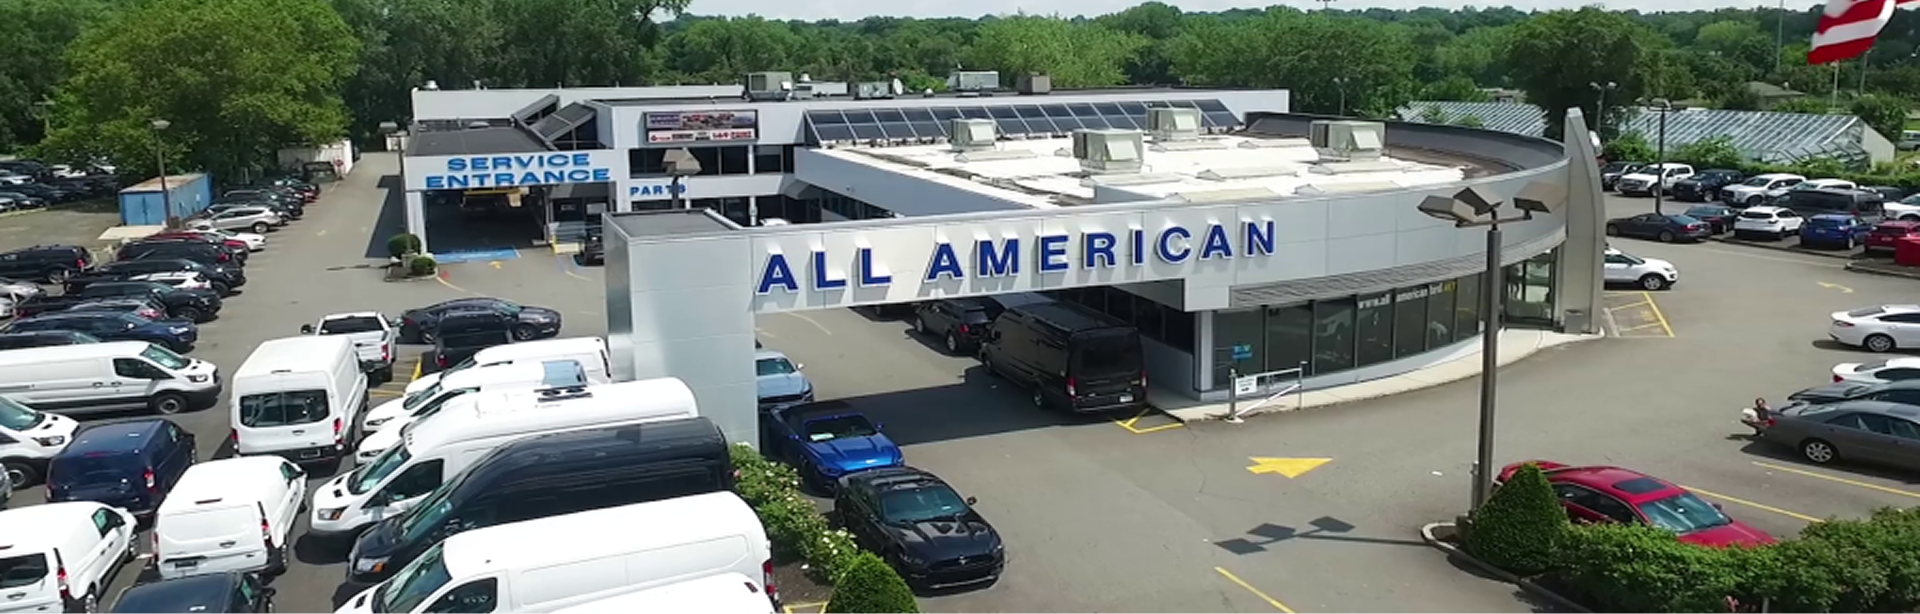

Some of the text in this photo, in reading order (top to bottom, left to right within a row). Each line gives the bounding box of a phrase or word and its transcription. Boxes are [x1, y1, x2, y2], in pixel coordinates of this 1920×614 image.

[447, 153, 590, 171] SERVICE
[425, 168, 610, 189] ENTRANCE
[756, 219, 1275, 295] ALL AMERICAN
